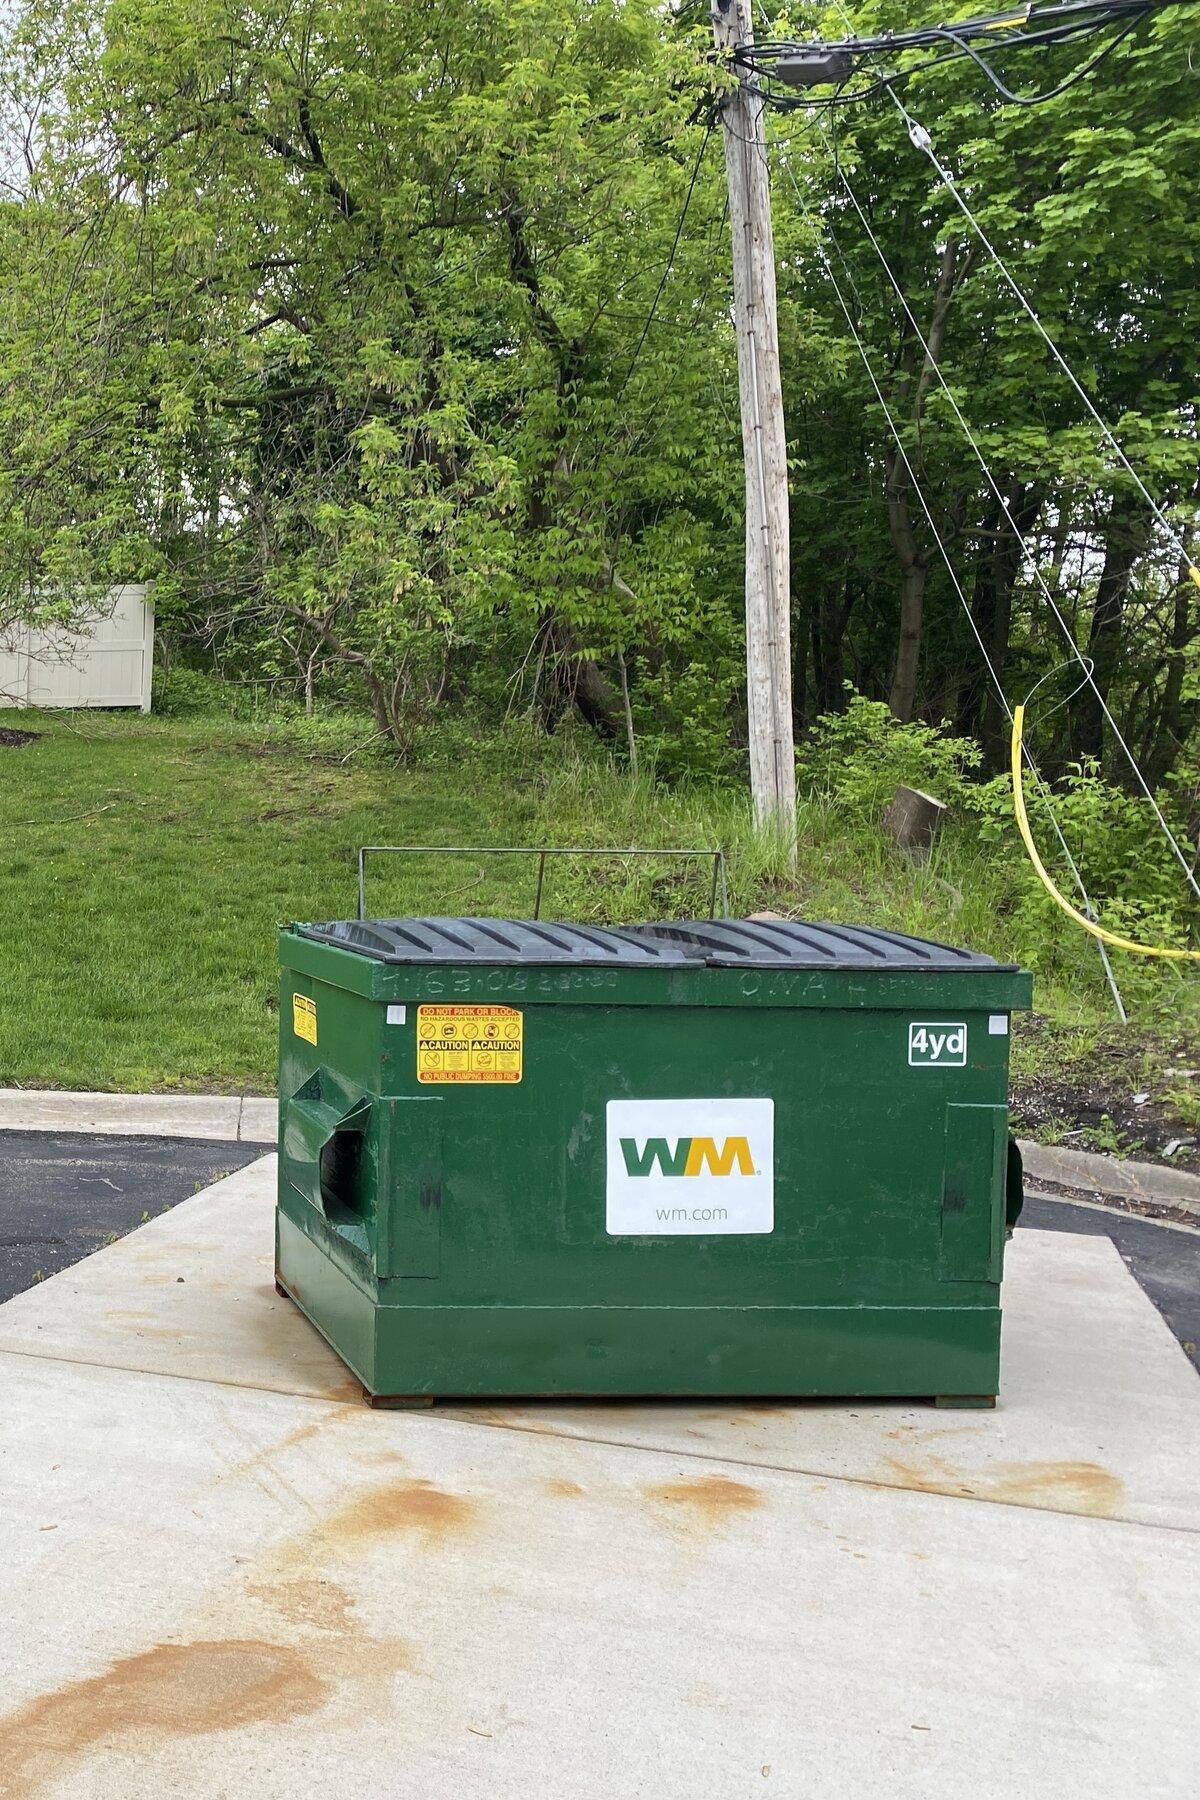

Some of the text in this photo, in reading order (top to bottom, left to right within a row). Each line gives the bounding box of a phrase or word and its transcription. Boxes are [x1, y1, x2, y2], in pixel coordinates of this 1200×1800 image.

[423, 1008, 434, 1016] DO
[436, 1008, 453, 1016] NOT
[454, 1008, 475, 1016] PARK
[477, 1008, 489, 1016] OR
[428, 1041, 468, 1050] CAUTION
[481, 1041, 520, 1050] CAUTION
[912, 1028, 964, 1060] 4yd
[423, 1072, 433, 1080] NO
[434, 1072, 455, 1080] PUBLIC
[455, 1072, 482, 1080] DUMPING
[503, 1072, 517, 1080] FINE
[619, 1136, 757, 1177] WM
[656, 1208, 728, 1221] wm.com
